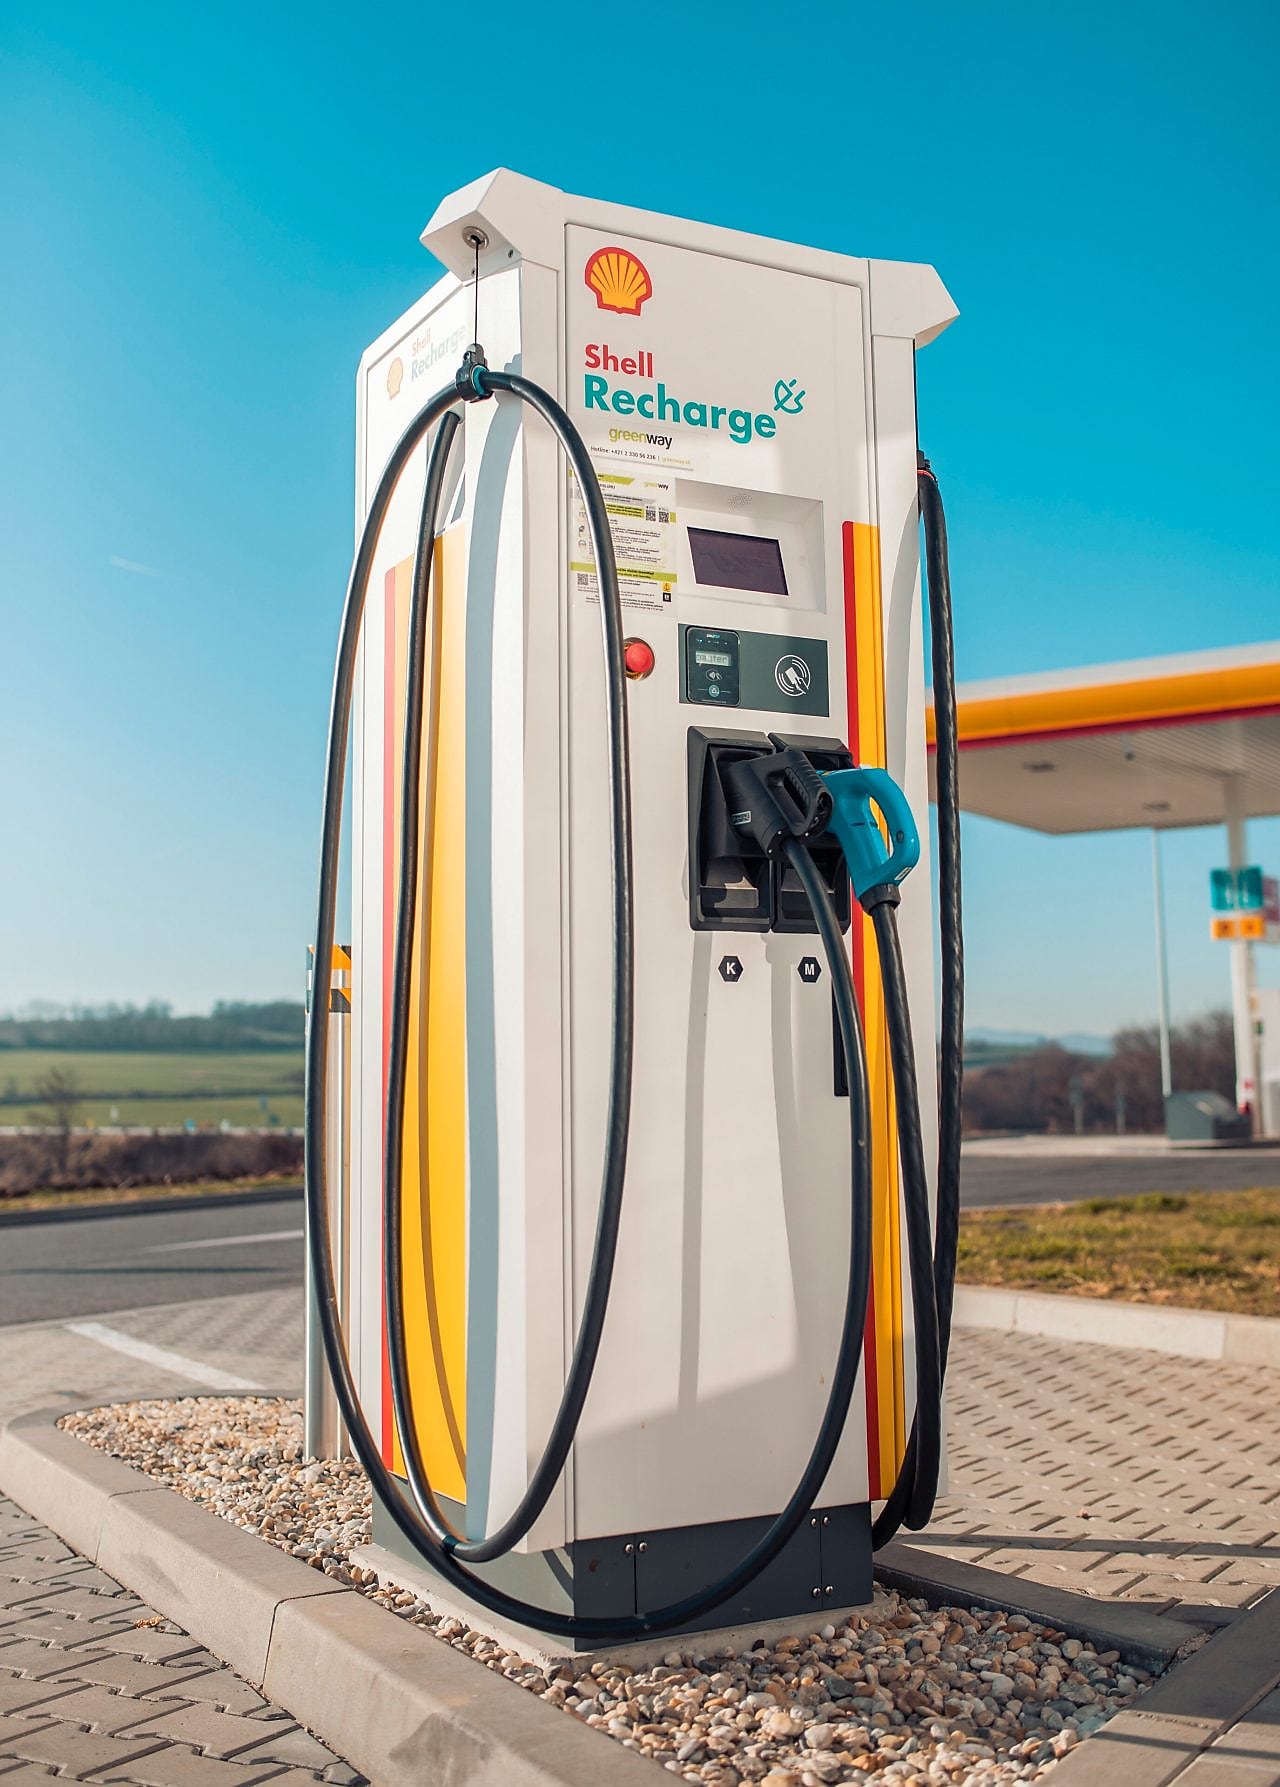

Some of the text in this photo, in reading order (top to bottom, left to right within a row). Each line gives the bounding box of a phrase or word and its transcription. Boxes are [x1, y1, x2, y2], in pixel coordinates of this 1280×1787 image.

[411, 325, 467, 382] Recharge
[584, 343, 654, 378] Shell
[584, 373, 777, 444] Recharge
[608, 427, 673, 450] greenway
[726, 962, 736, 975] K
[804, 962, 815, 976] M
